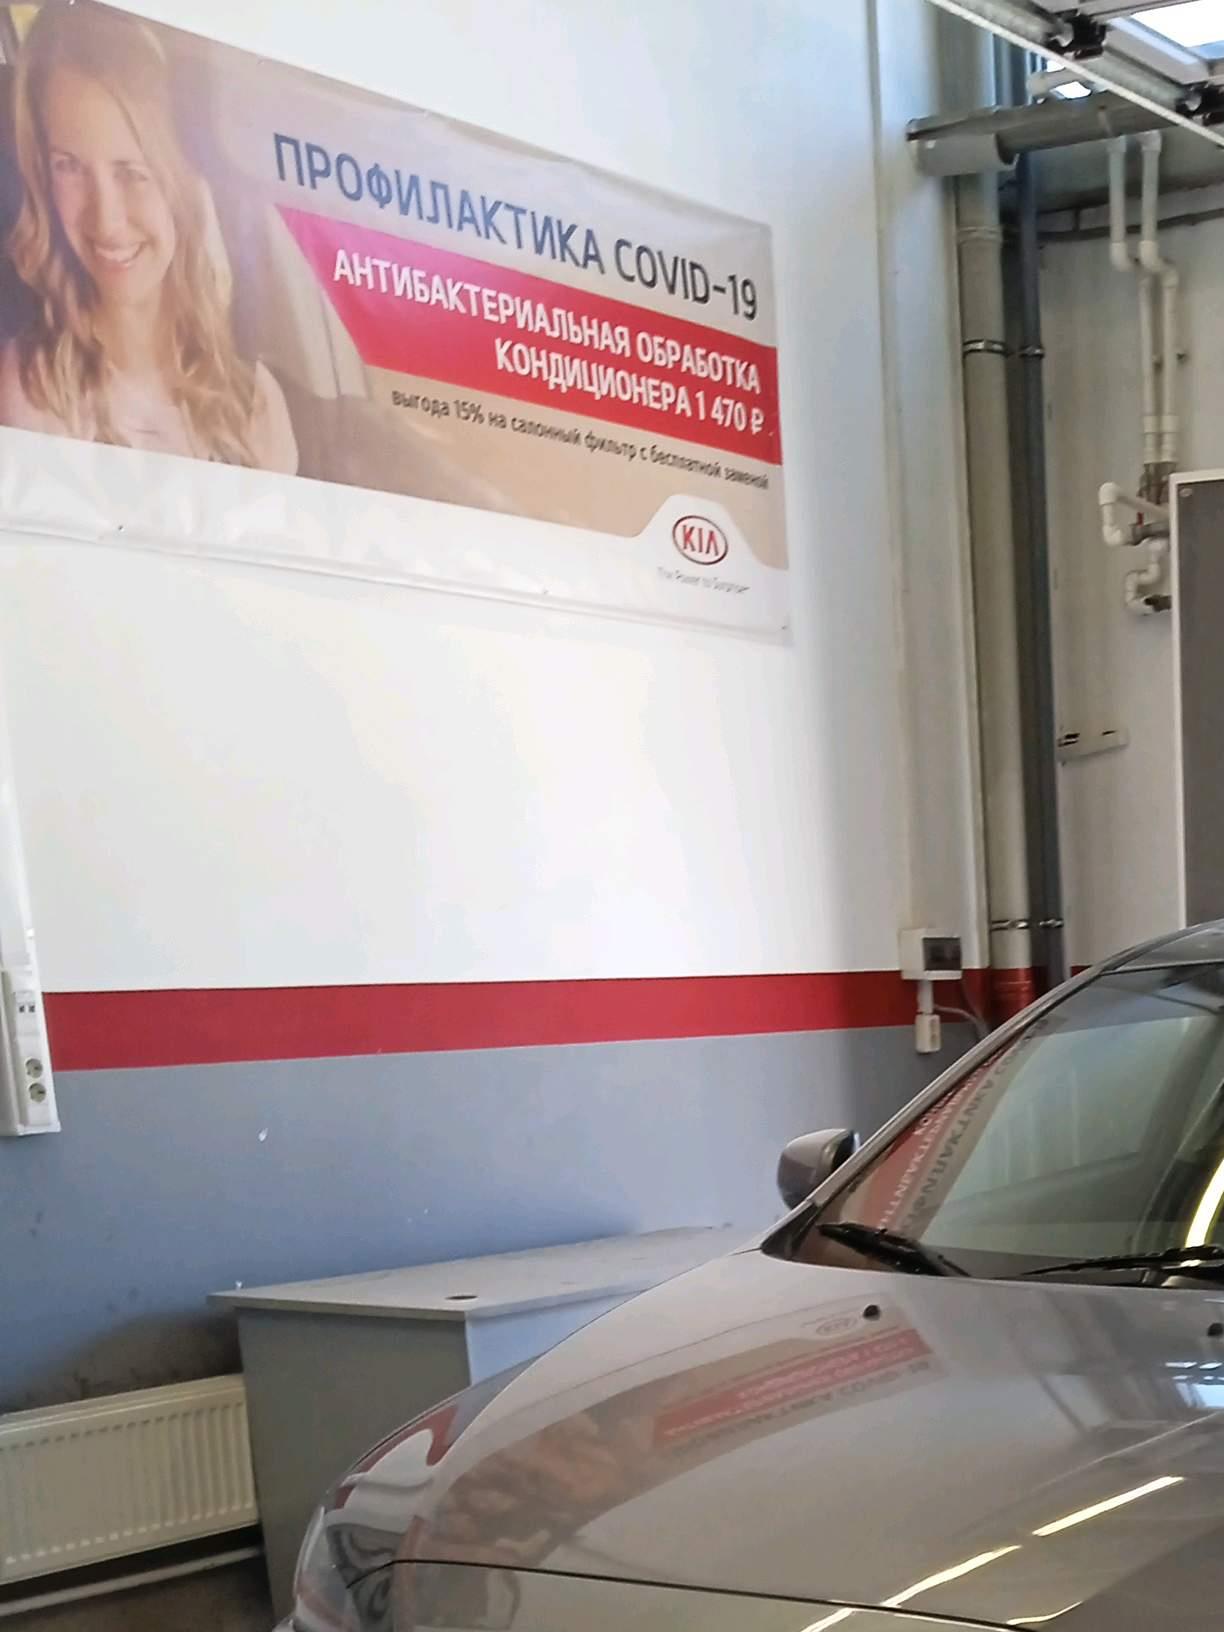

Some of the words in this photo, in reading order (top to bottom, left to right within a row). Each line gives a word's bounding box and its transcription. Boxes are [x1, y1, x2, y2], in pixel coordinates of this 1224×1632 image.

[273, 132, 605, 275] ПРОФИЛАКТИКА
[614, 238, 758, 321] COVID-19
[332, 249, 631, 358] АНТИБАКТЕРИАЛЬНАЯ
[636, 331, 761, 395] ОБРАБОТКА
[391, 390, 450, 418] выгода
[453, 399, 485, 425] 15%
[488, 411, 508, 429] на
[494, 337, 692, 418] КОНДИЦИОНЕРА
[695, 390, 706, 421] 1
[710, 396, 748, 432] 470
[682, 524, 720, 557] KIA
